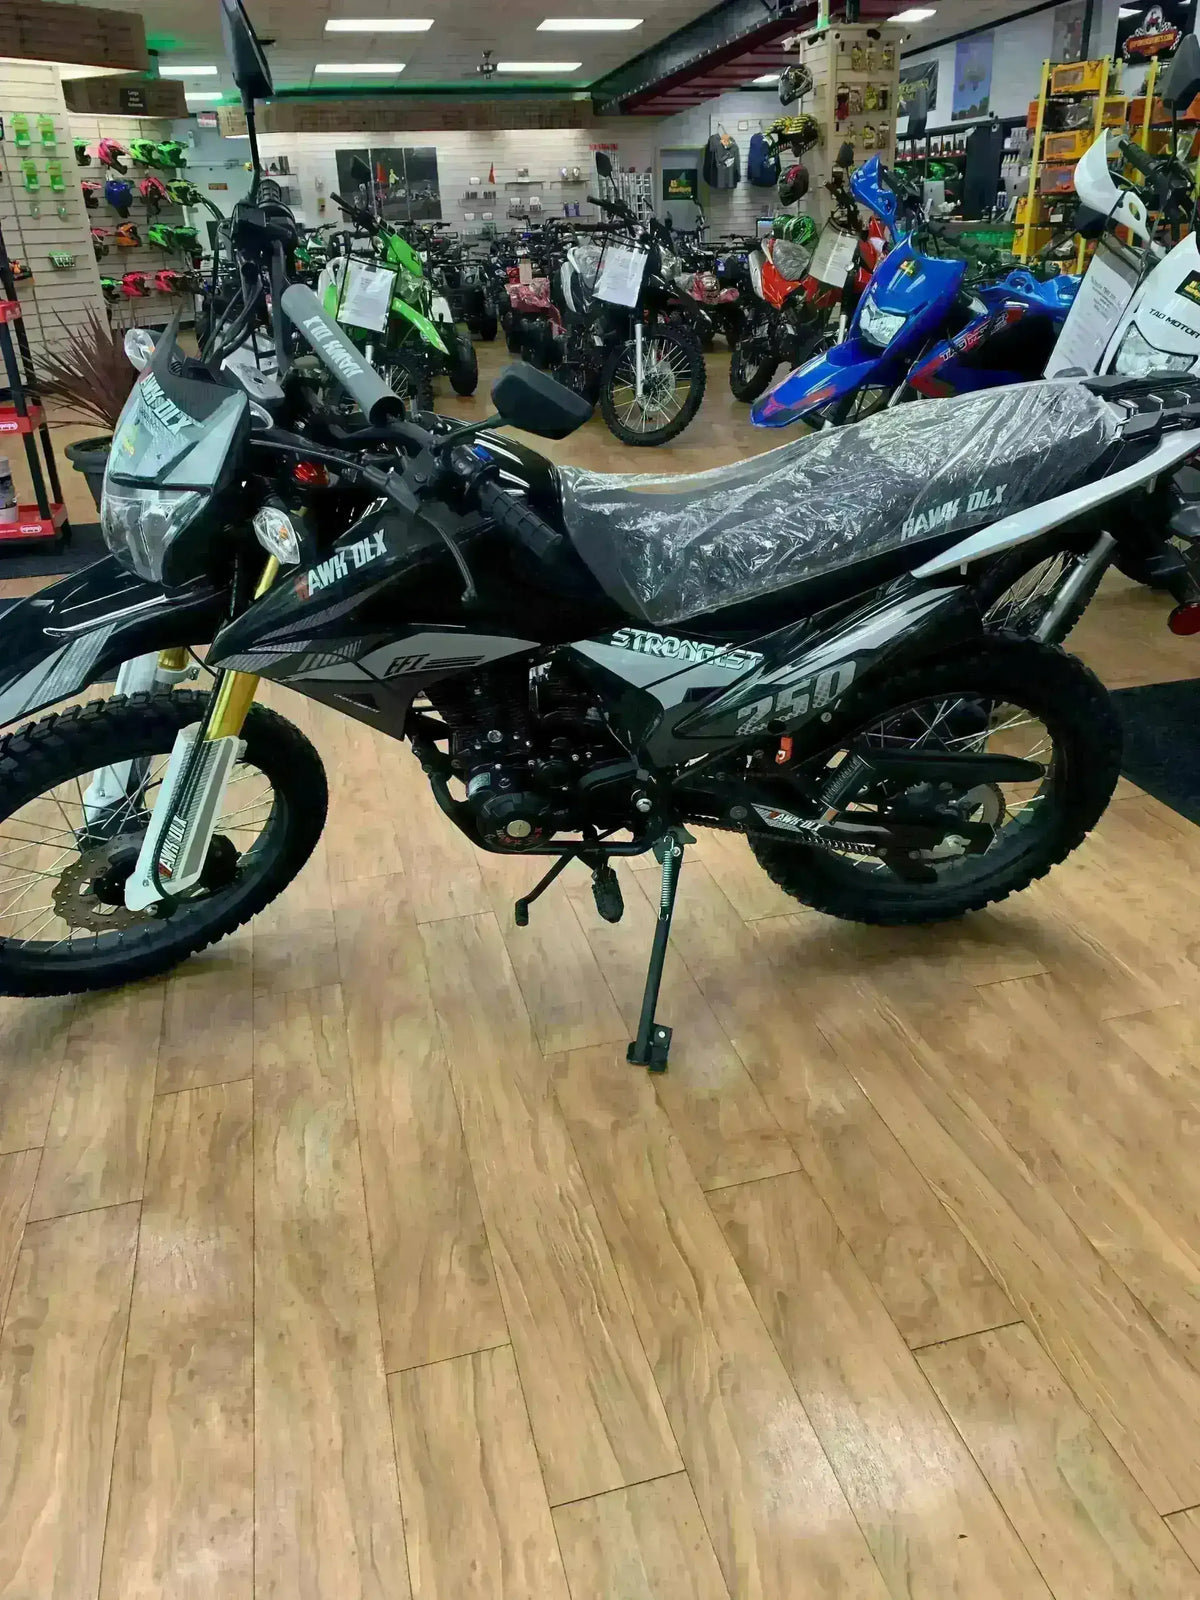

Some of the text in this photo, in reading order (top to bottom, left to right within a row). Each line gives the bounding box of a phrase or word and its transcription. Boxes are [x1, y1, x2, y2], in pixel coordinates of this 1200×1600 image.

[302, 315, 334, 343] DLX
[322, 340, 365, 378] HAWK
[152, 398, 194, 436] DLX
[900, 483, 1008, 542] HAWK DLX
[350, 529, 388, 569] DLX
[383, 653, 431, 677] EFI
[734, 660, 857, 736] 250
